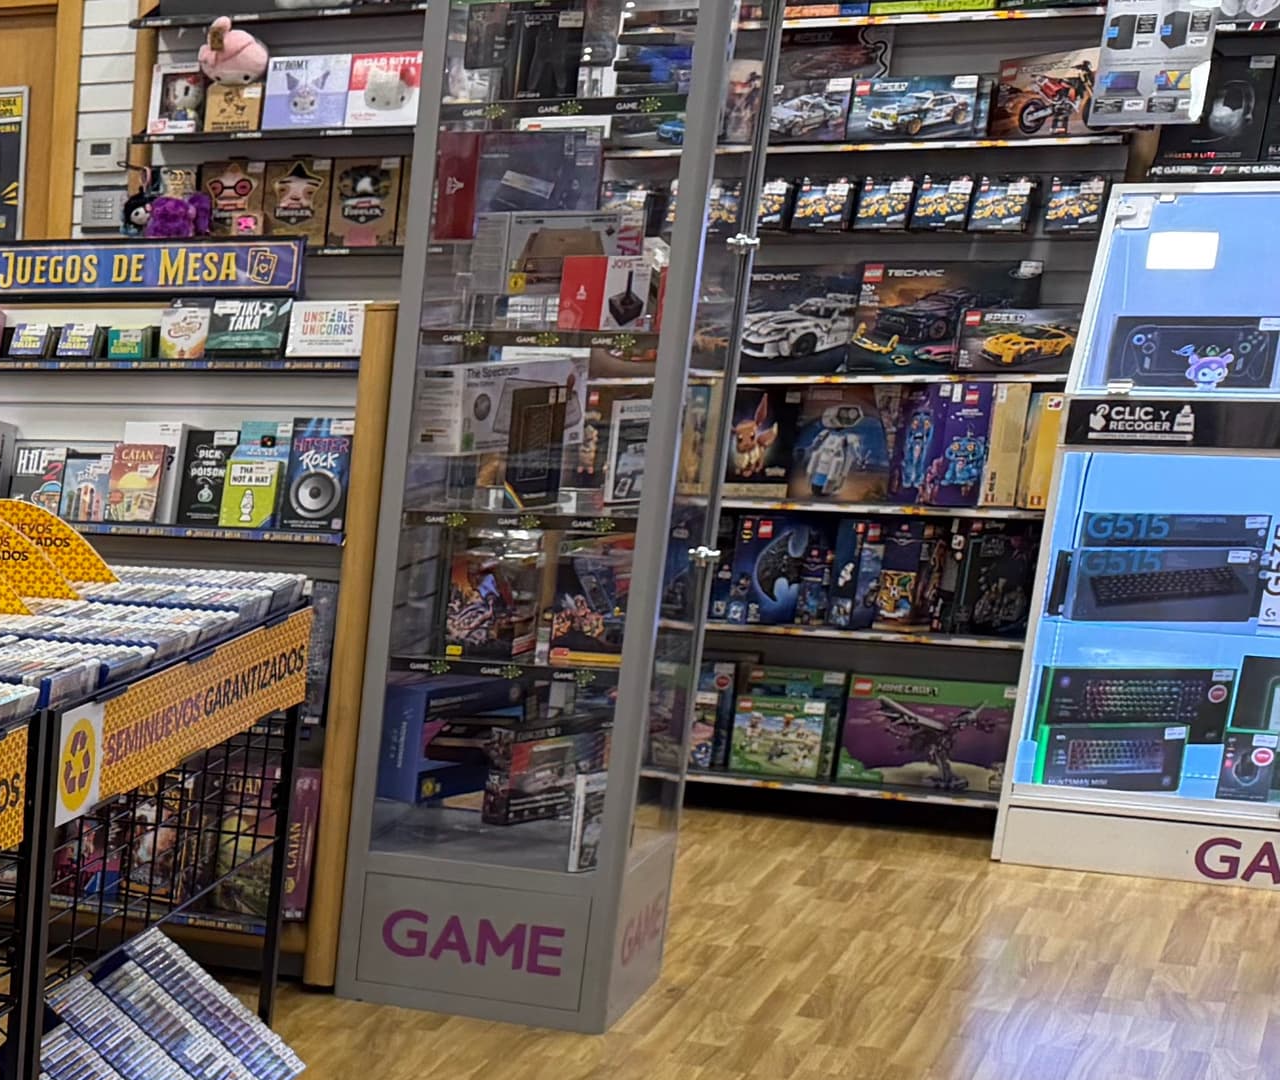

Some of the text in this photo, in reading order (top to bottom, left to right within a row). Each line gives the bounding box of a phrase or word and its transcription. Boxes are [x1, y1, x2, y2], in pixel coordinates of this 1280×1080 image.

[1151, 166, 1162, 174] PC
[112, 255, 144, 284] DE
[159, 248, 237, 285] MESA
[888, 269, 944, 277] TECHNIC
[229, 316, 260, 331] TAKA
[302, 323, 354, 336] UNICORNS
[1111, 407, 1170, 420] CLIC Y
[1109, 421, 1171, 431] RECOGER
[121, 450, 154, 461] CATAN
[300, 450, 339, 470] ROCK
[191, 466, 226, 477] POISON
[1088, 513, 1170, 539] G515
[106, 645, 304, 767] SEMINUEVOS GARANTIZADOS
[382, 909, 565, 977] GAME
